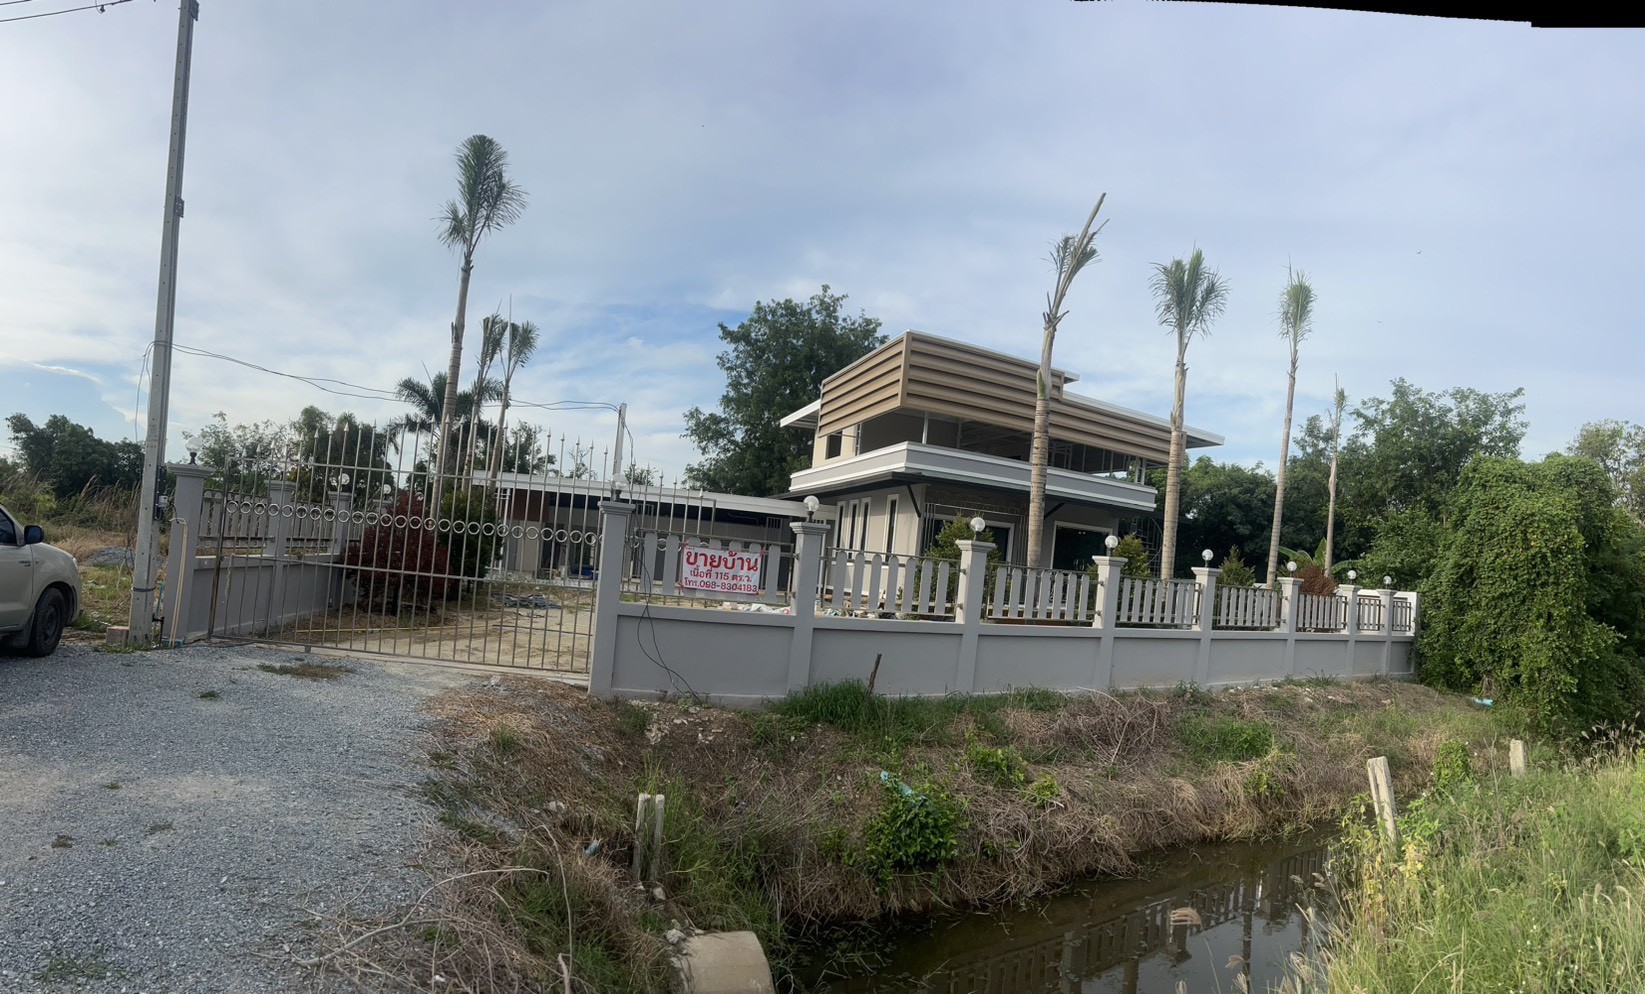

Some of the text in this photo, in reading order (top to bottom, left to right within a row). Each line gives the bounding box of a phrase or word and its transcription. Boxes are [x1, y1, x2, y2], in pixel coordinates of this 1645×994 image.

[686, 550, 758, 572] ขายบ้าน
[715, 572, 729, 580] 115
[731, 574, 752, 583] ตร.ว.
